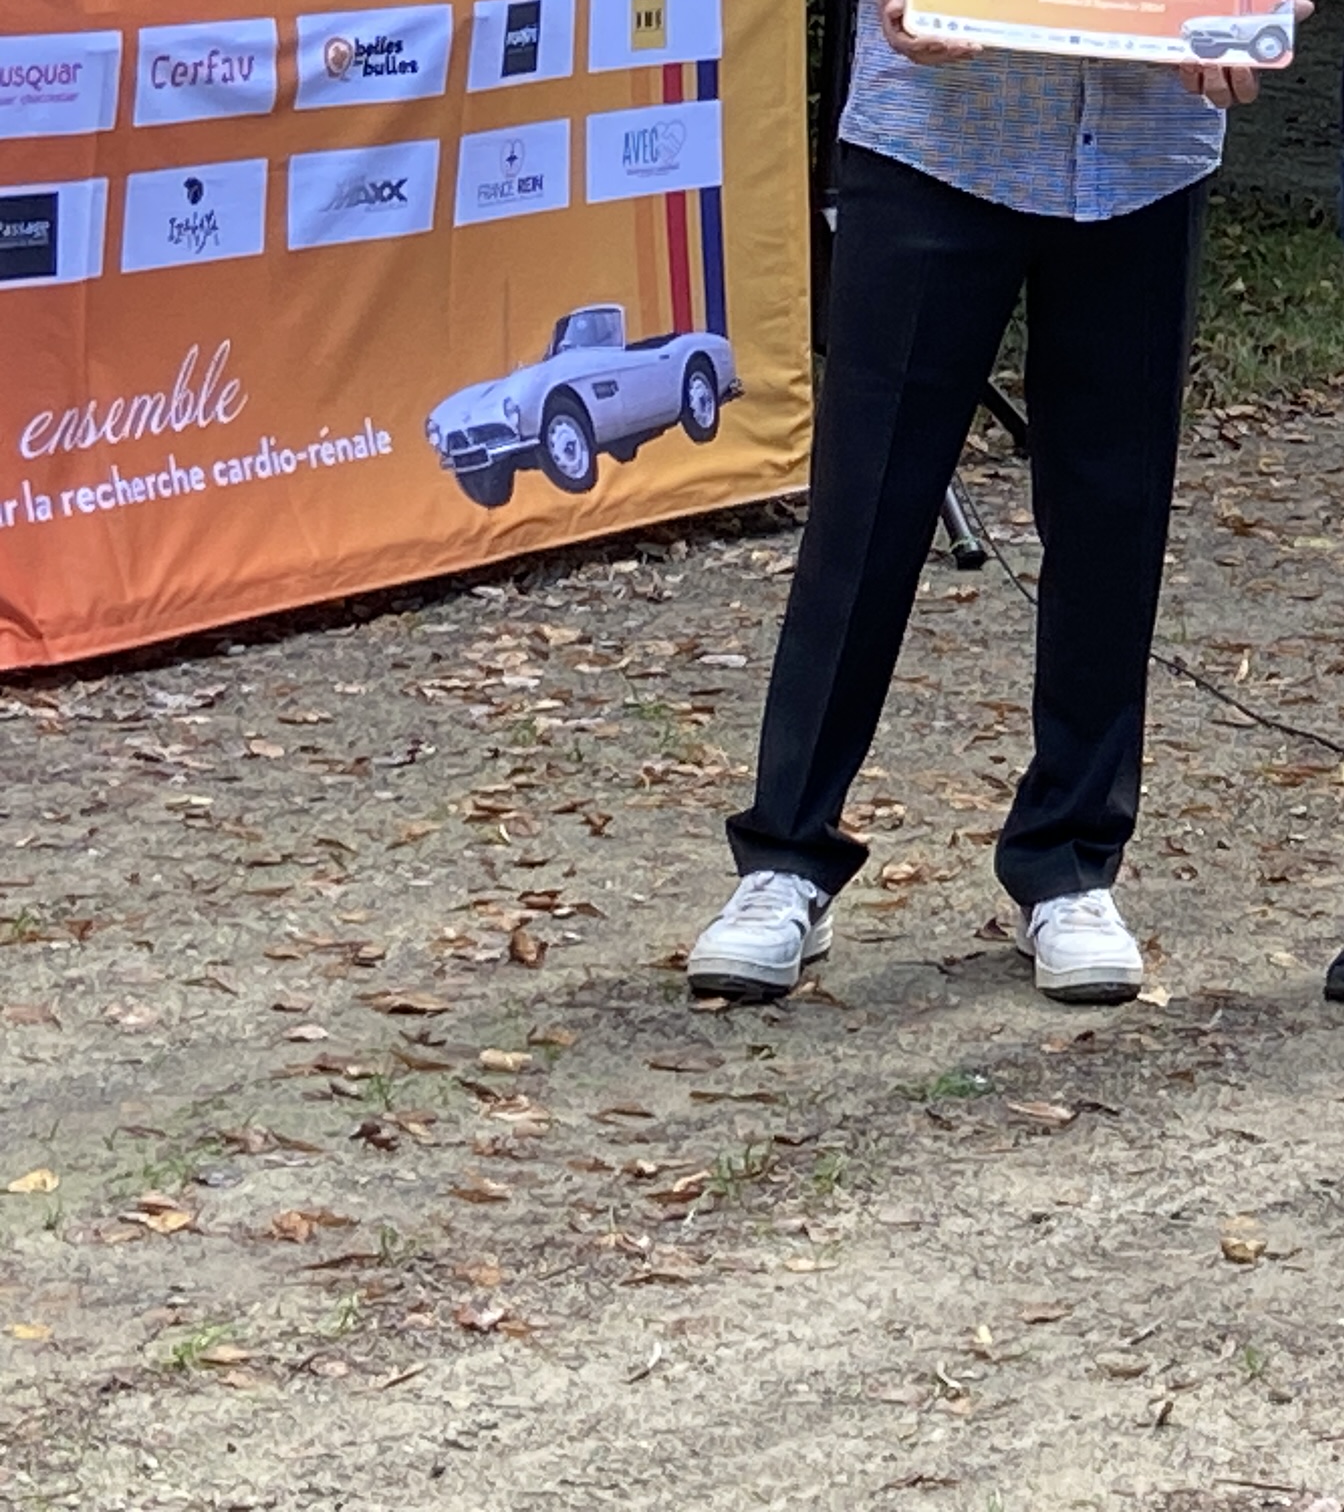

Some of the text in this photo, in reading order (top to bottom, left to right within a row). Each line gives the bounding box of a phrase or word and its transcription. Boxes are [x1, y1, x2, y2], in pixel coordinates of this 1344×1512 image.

[151, 49, 255, 89] Cerfav
[19, 339, 248, 460] ensemble
[22, 479, 53, 523] la
[60, 452, 207, 517] recherche
[212, 416, 392, 487] cardio-rénale
